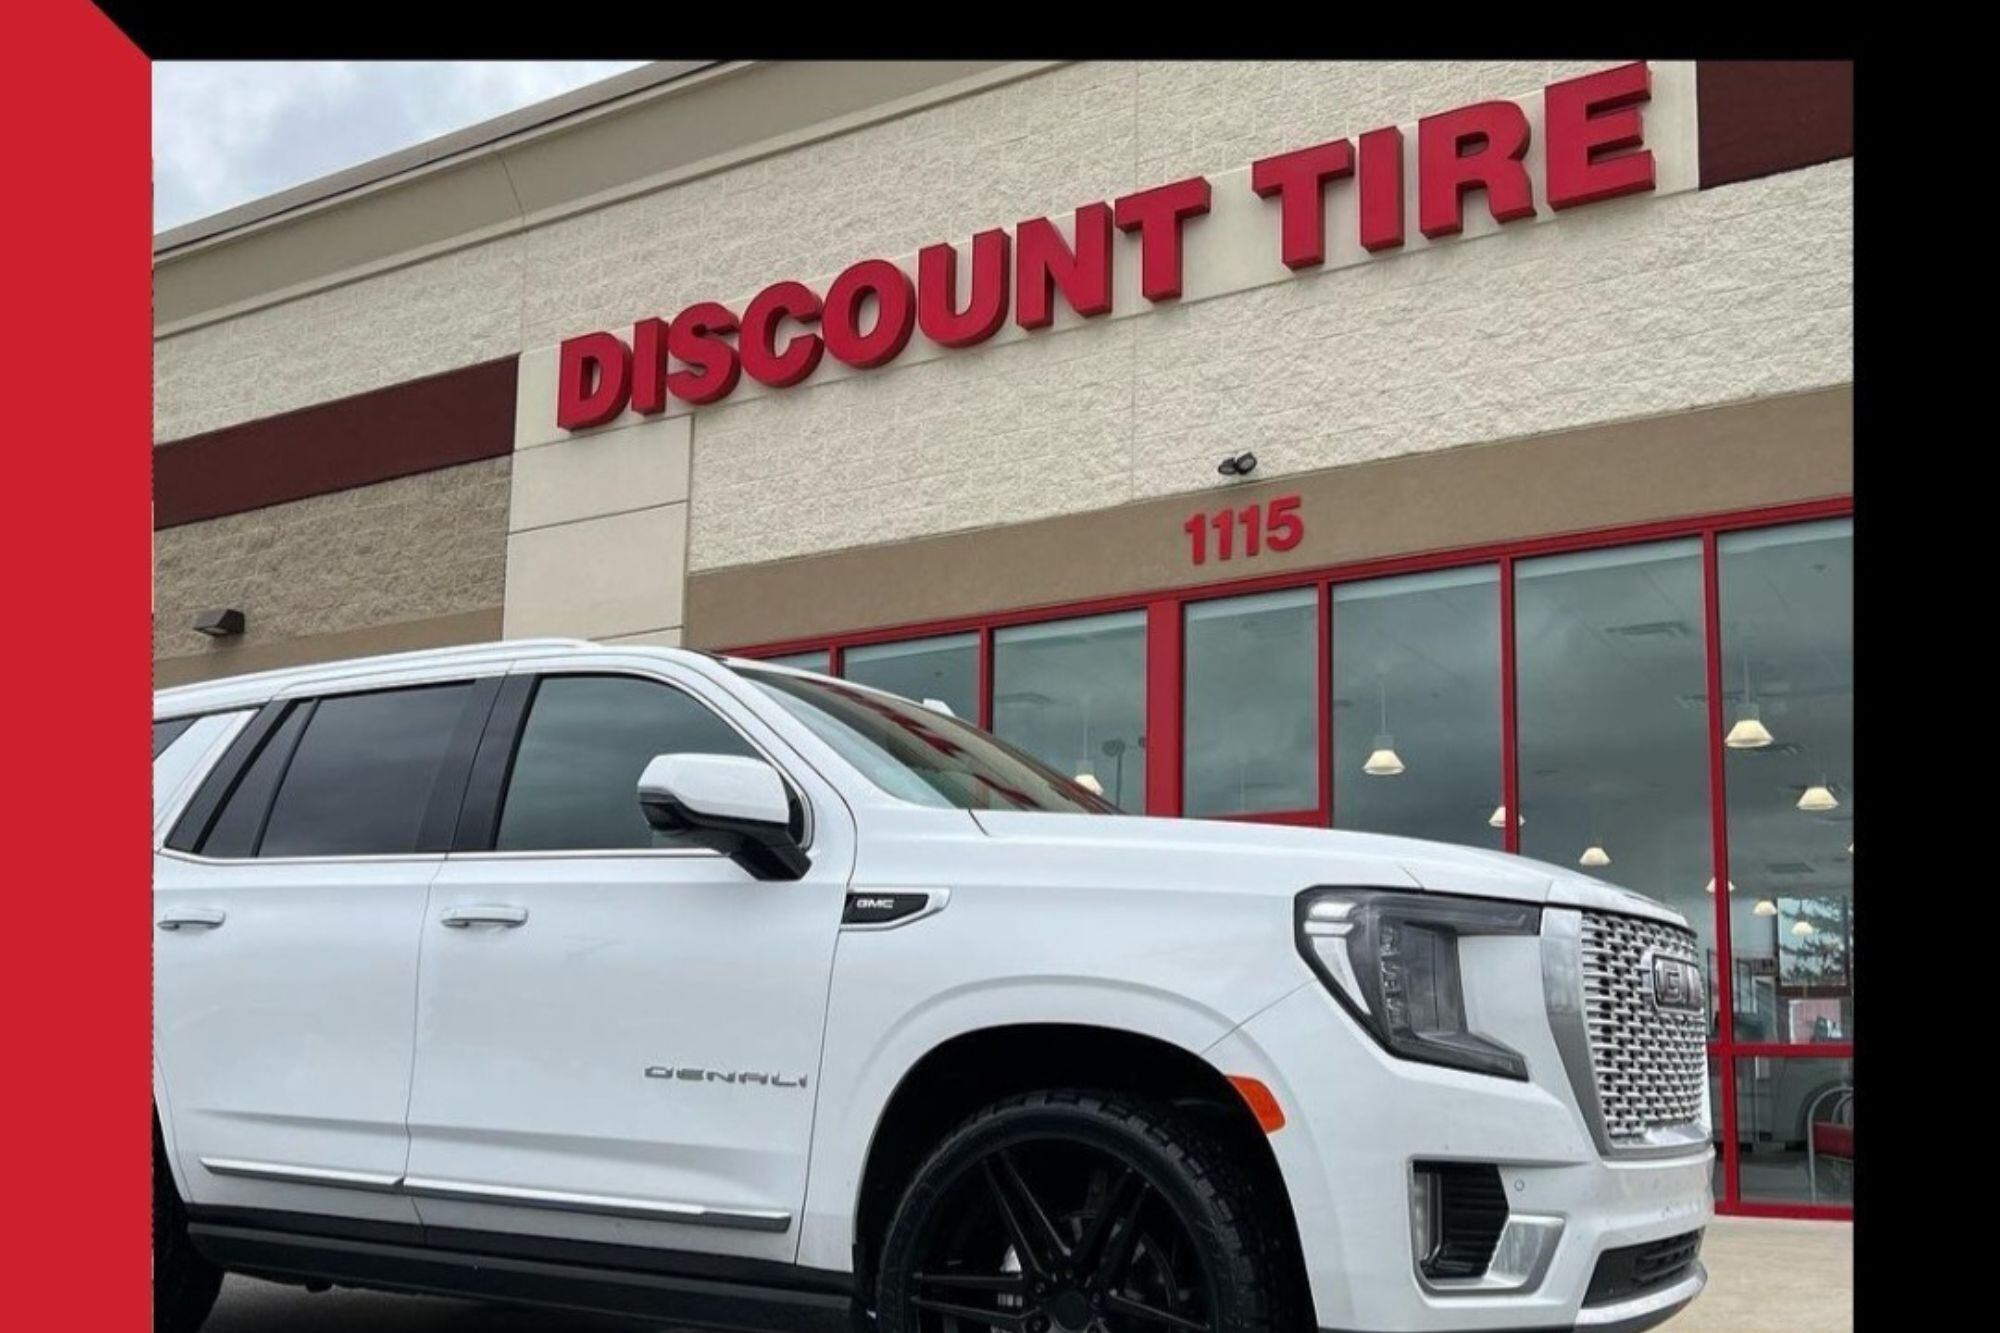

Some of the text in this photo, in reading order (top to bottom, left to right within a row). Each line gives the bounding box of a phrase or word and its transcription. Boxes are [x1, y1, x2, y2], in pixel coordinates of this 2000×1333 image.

[557, 61, 1656, 432] DISCOUNT TIRE
[1184, 496, 1305, 565] 1115
[856, 898, 895, 909] GMC
[645, 1065, 807, 1088] DENALI
